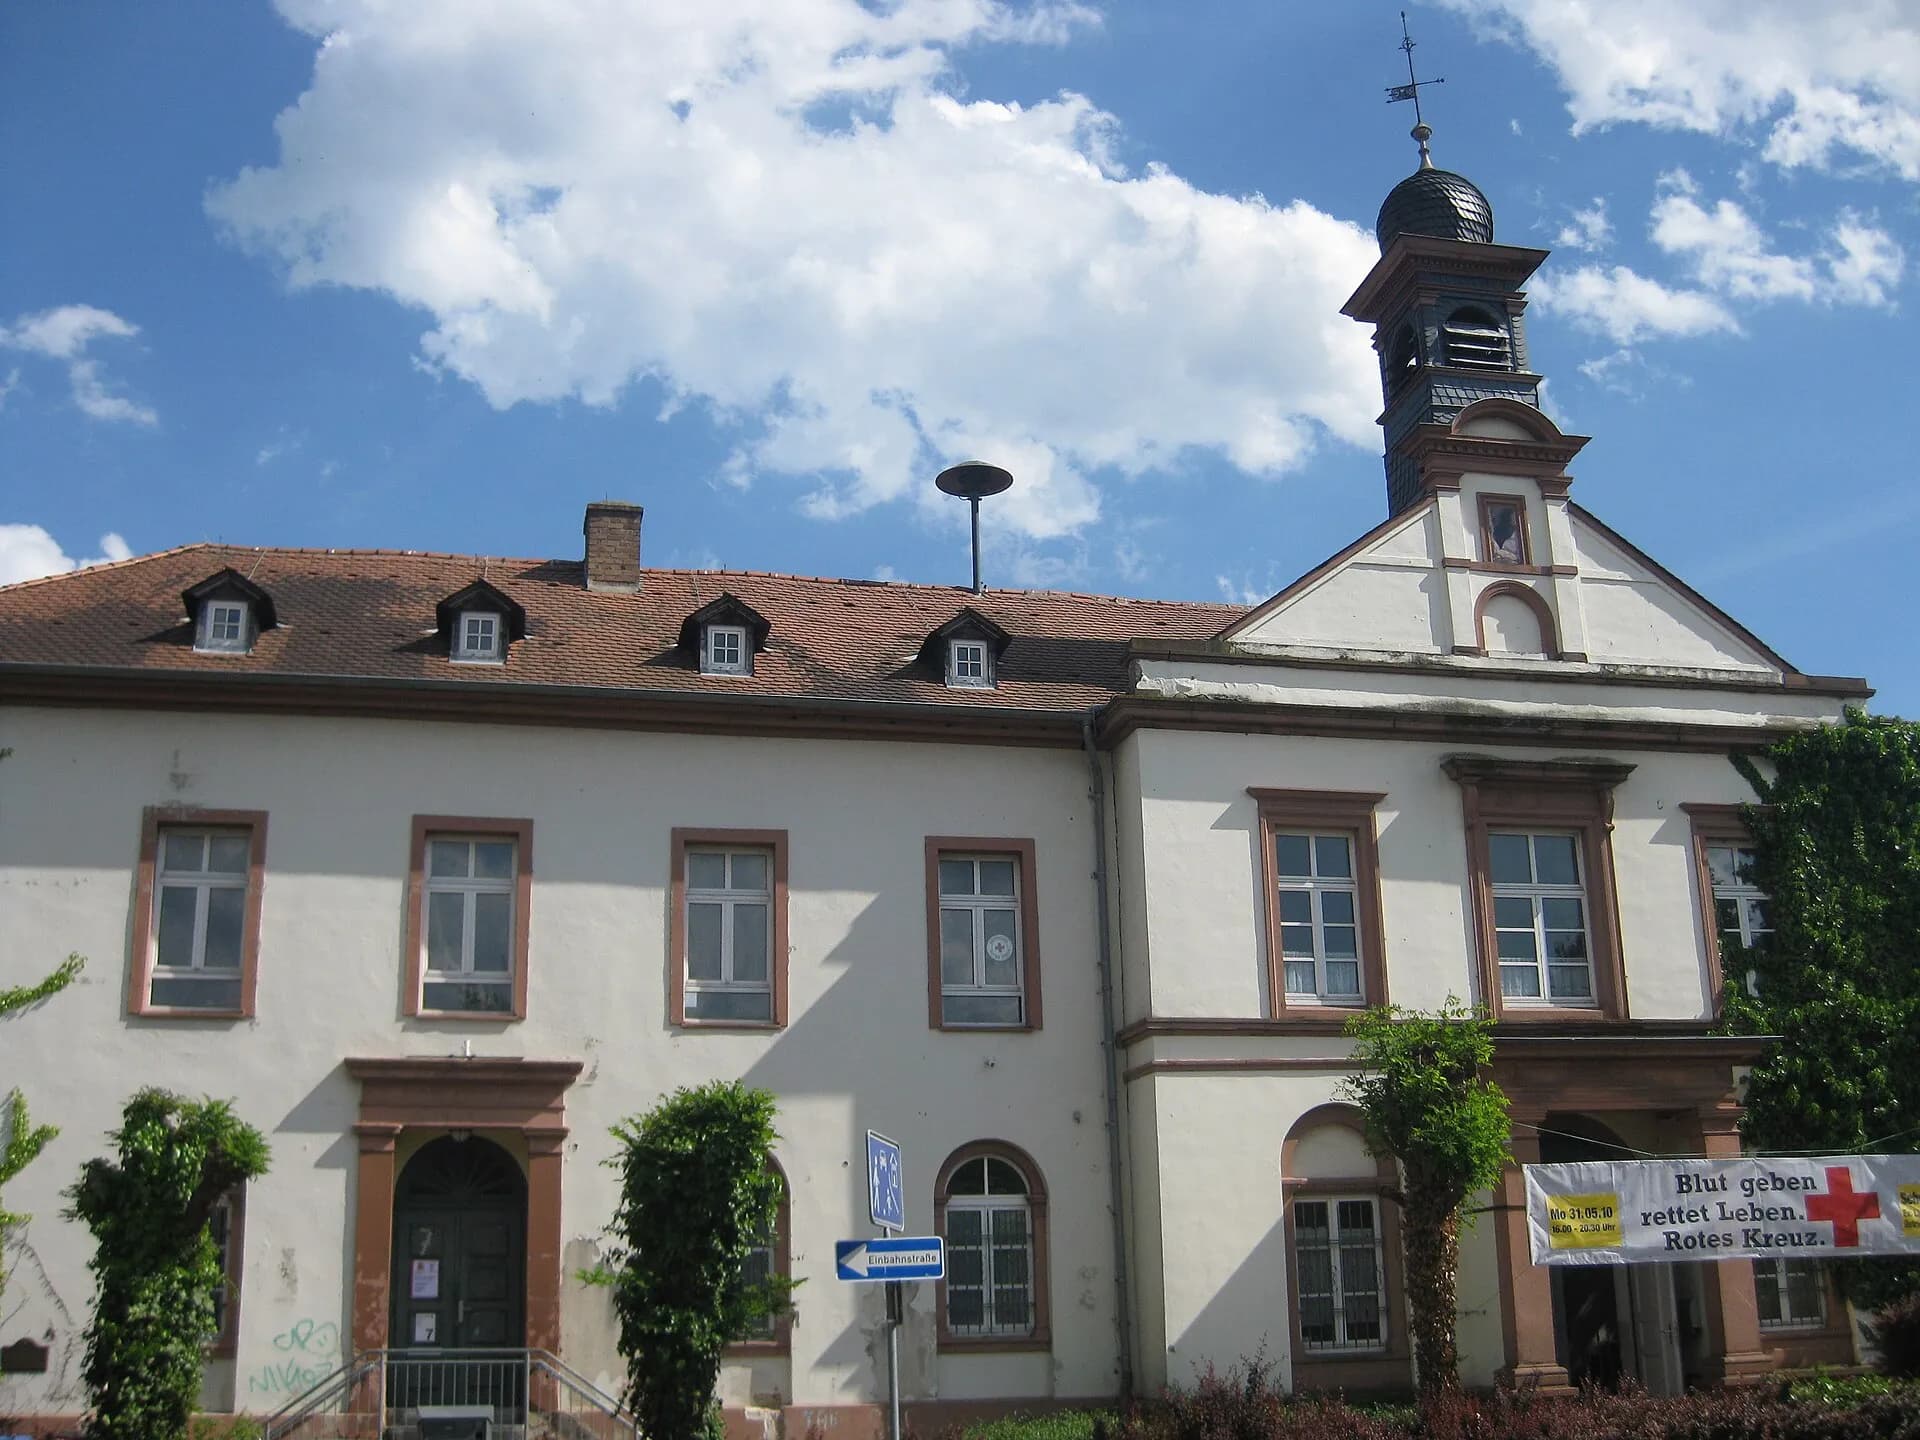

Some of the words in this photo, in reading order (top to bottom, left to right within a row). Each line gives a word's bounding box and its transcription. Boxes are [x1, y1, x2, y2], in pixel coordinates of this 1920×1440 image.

[1674, 1173, 1728, 1194] Blut
[1740, 1172, 1817, 1197] geben
[1550, 1207, 1566, 1220] Mo
[1568, 1206, 1613, 1220] 31.05.10
[1641, 1204, 1710, 1226] rettet
[1716, 1202, 1804, 1221] Leben.
[1579, 1223, 1601, 1233] 20.30
[1602, 1223, 1616, 1232] Uhr
[1662, 1229, 1733, 1251] Rotes
[1742, 1228, 1825, 1248] Kreuz.
[868, 1253, 937, 1265] Einbahnstraße
[425, 1328, 434, 1341] 7
